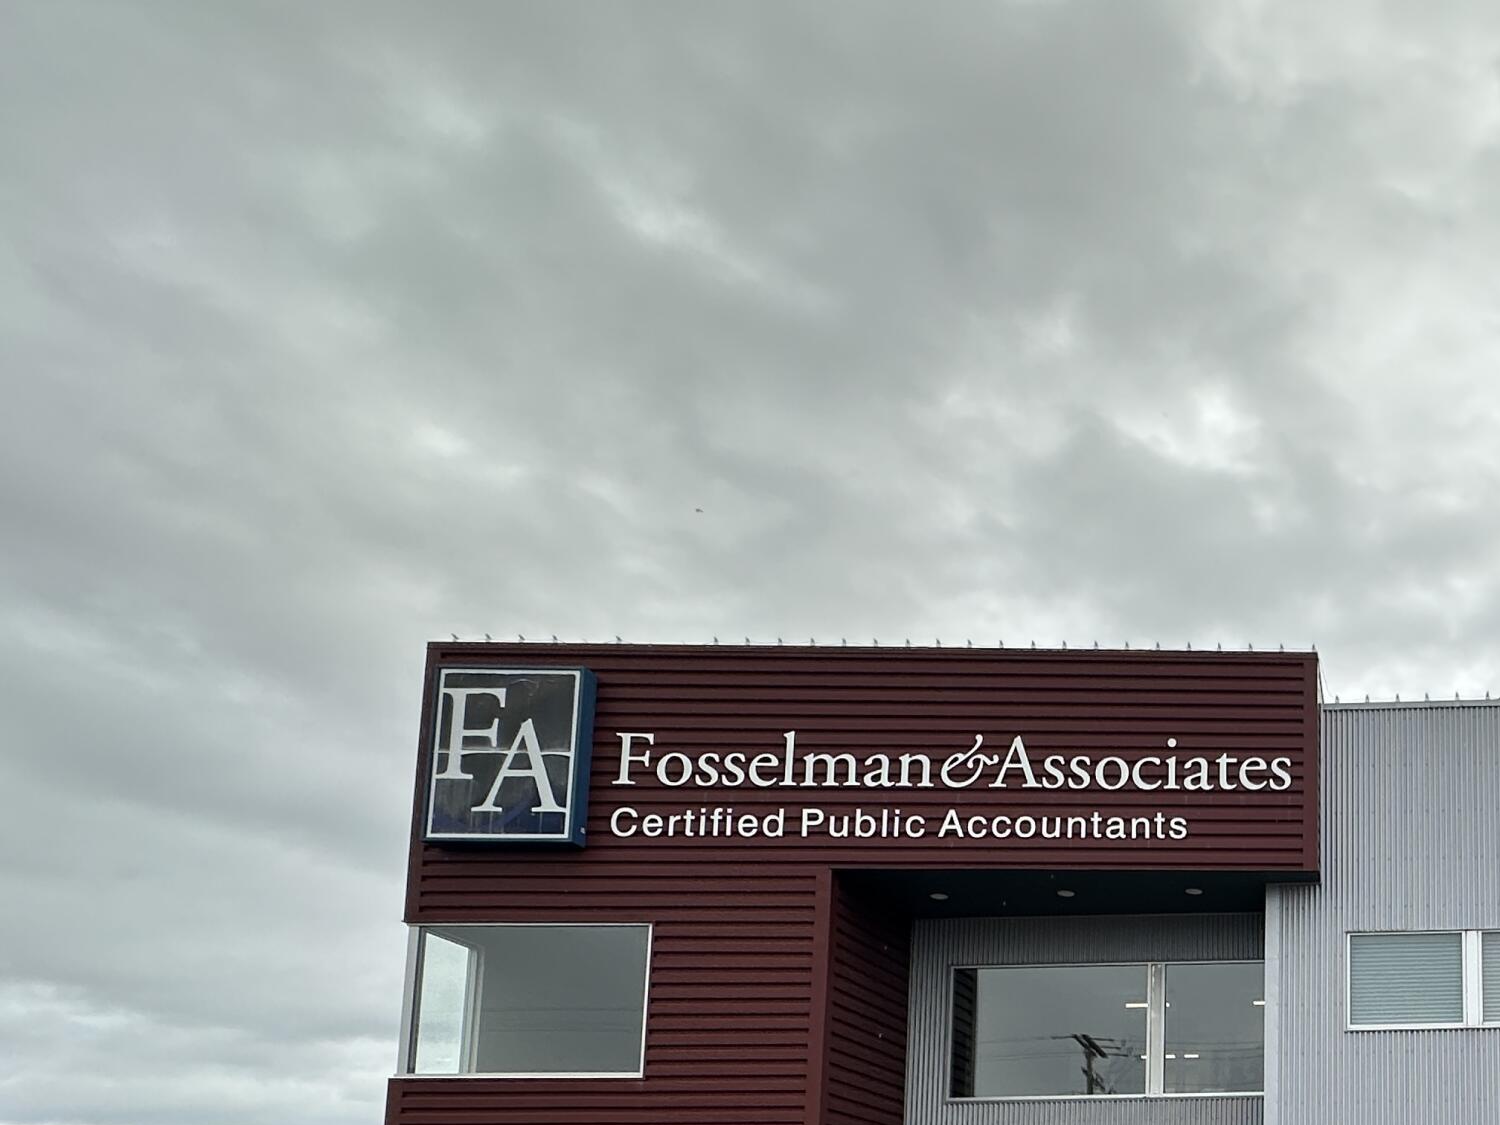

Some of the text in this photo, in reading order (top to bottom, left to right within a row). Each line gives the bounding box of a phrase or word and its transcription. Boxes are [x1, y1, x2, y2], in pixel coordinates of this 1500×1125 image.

[611, 730, 935, 787] Fosselman
[989, 735, 1292, 791] Associates
[610, 807, 1188, 840] Certified Public Accountants
